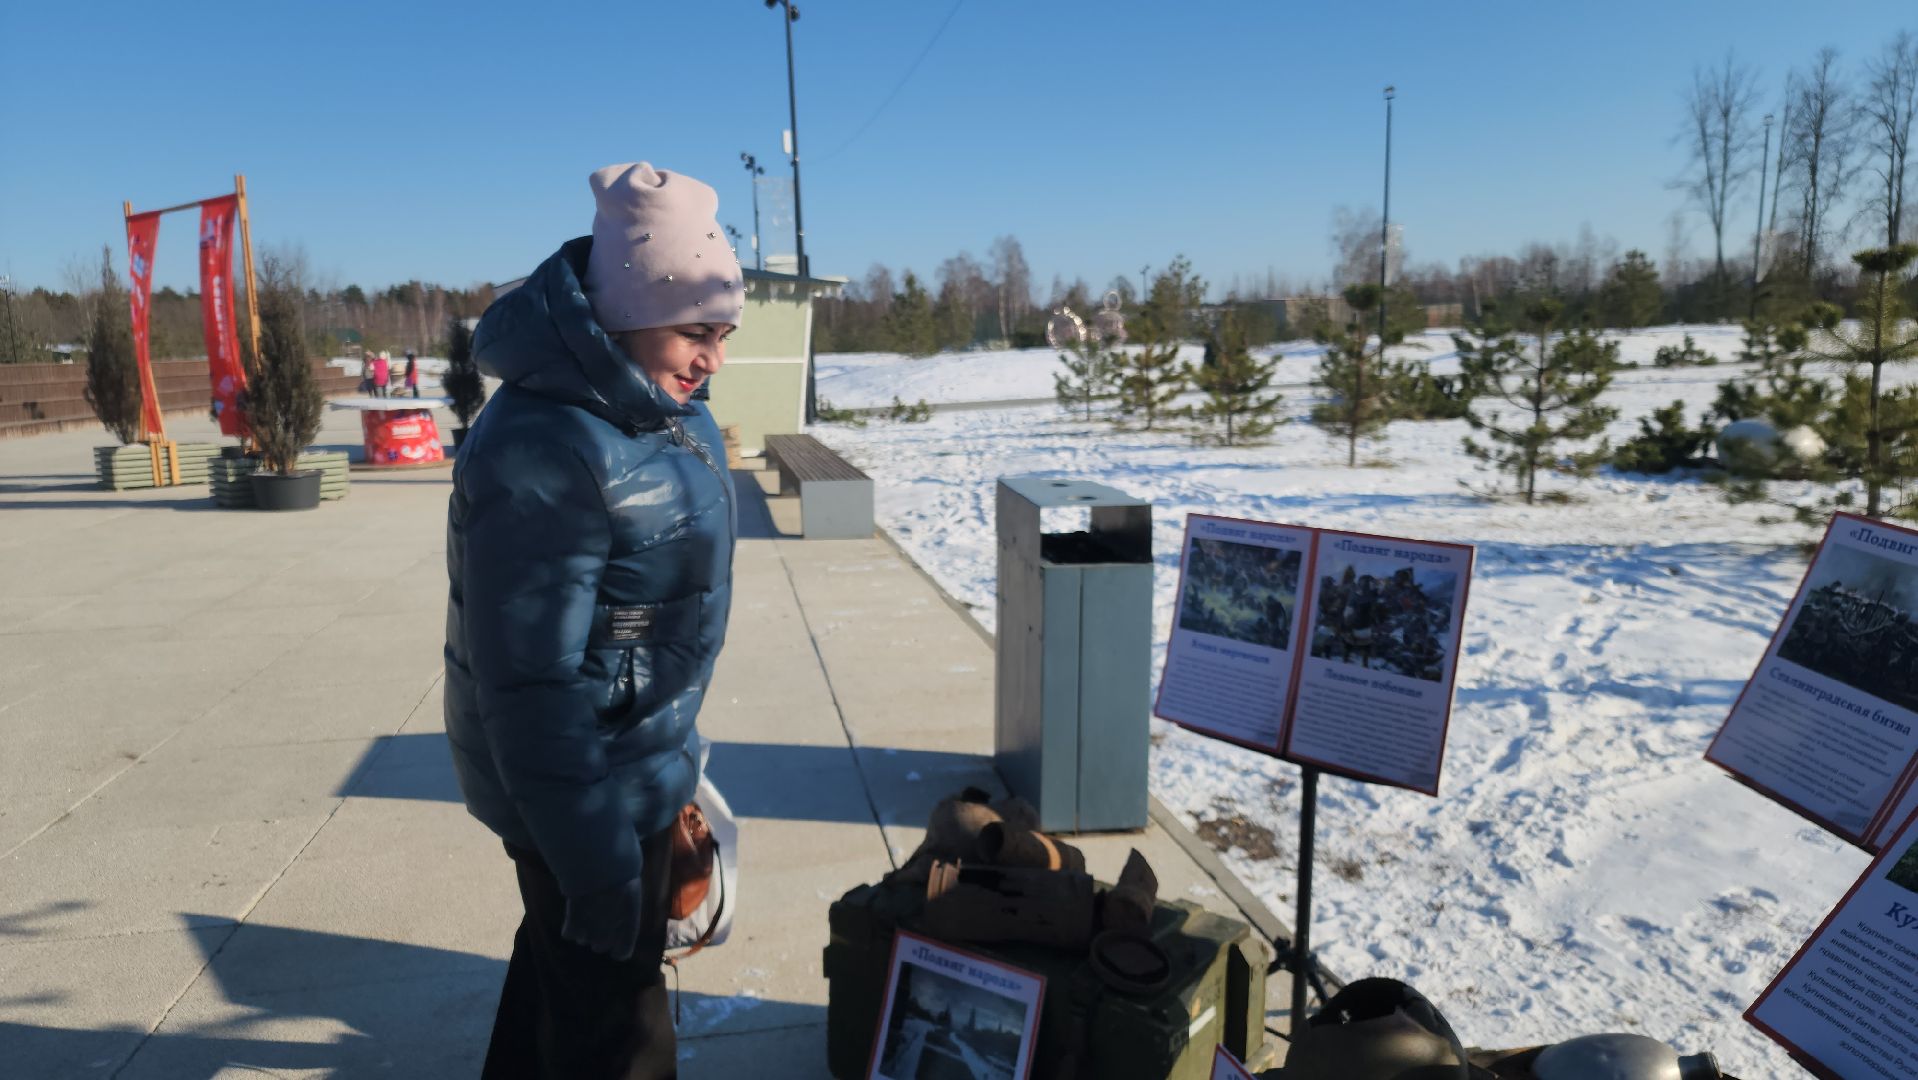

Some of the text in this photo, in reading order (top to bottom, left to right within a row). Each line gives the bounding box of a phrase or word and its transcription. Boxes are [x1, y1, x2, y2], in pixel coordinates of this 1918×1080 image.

[1333, 539, 1391, 557] «Подвиг
[1849, 527, 1918, 556] «Подвиг
[1769, 666, 1912, 737] Сталинградская битва
[1884, 901, 1918, 930] Ку
[1840, 928, 1876, 952] войском
[1876, 948, 1888, 959] во
[1857, 920, 1894, 947] Крупное
[1861, 956, 1914, 990] московским
[1864, 972, 1890, 991] части
[1802, 982, 1858, 1022] Куликовской
[1881, 1033, 1909, 1055] стала
[1886, 1002, 1908, 1020] года
